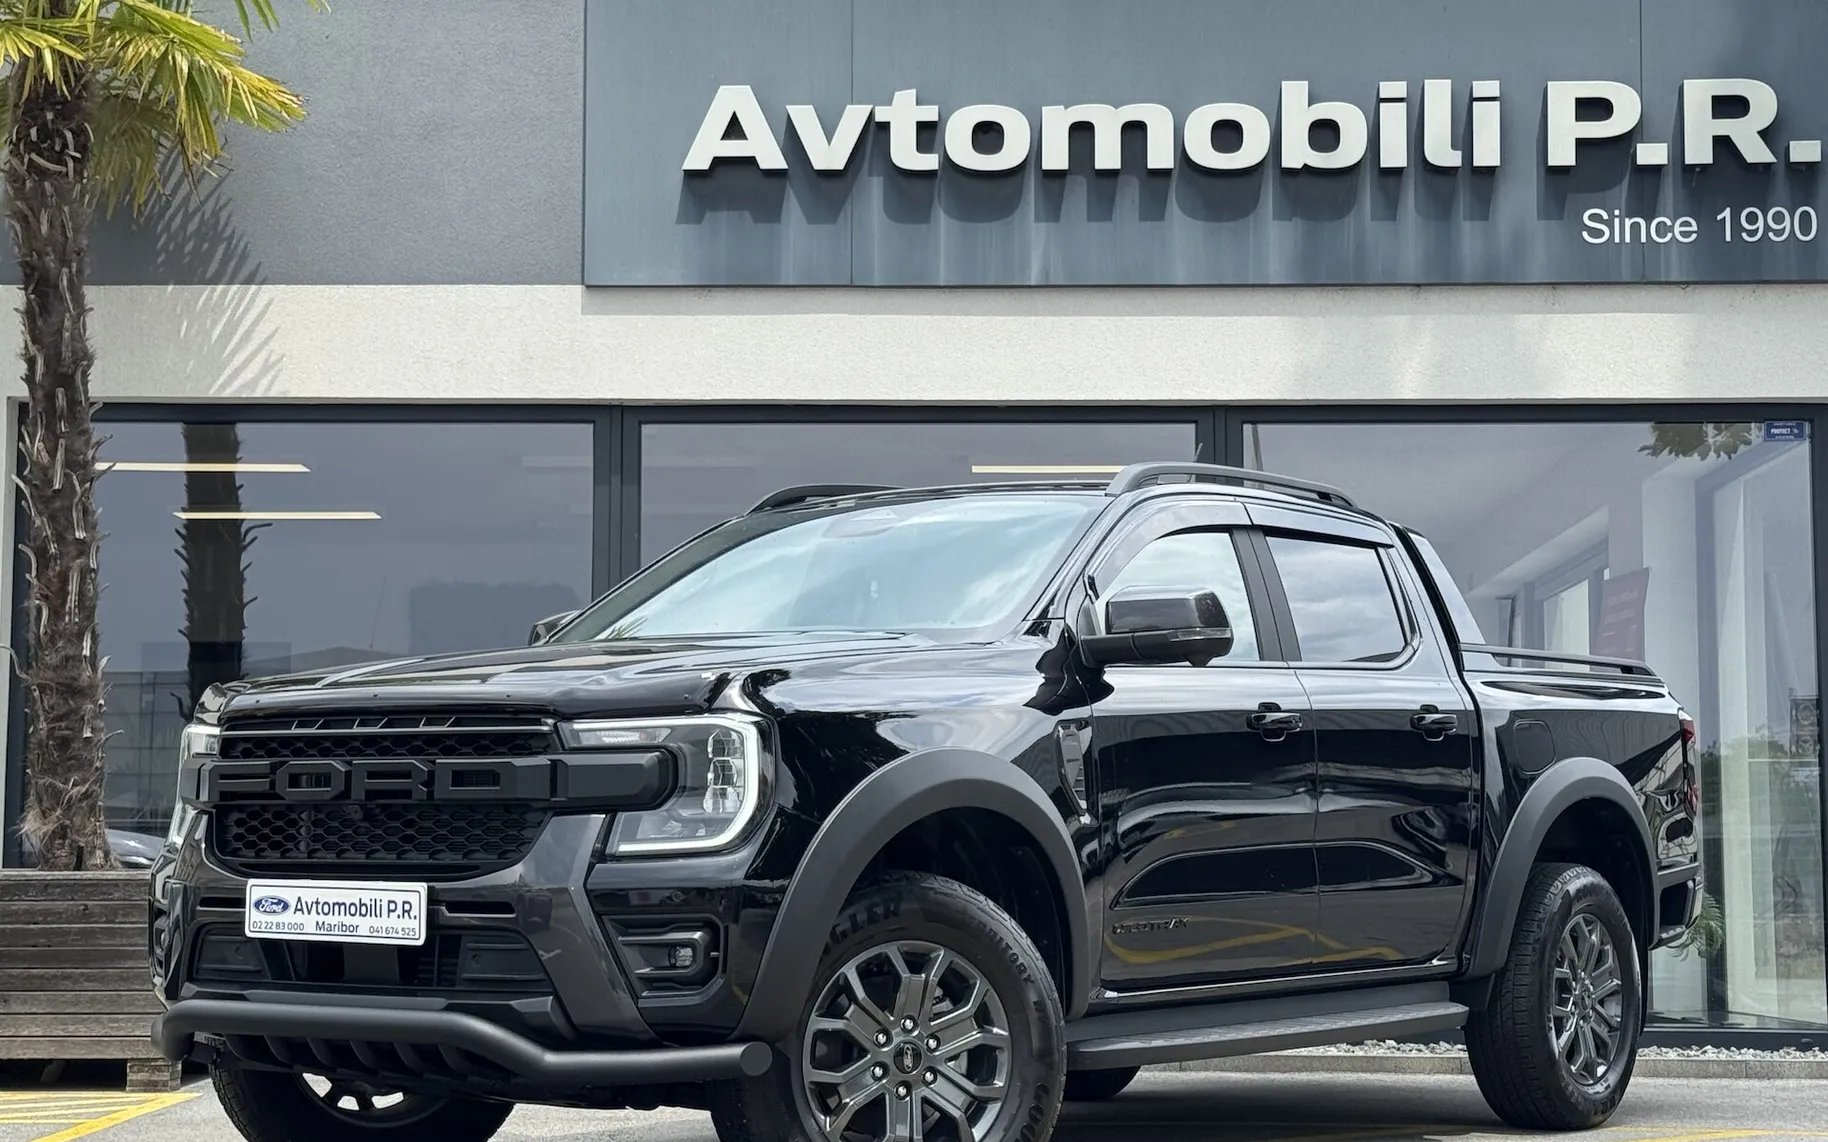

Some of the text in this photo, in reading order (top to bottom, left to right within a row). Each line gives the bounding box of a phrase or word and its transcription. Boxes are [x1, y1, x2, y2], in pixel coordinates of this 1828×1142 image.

[682, 78, 1821, 172] Avtomobili P.R.
[1581, 206, 1817, 243] Since 1990
[204, 758, 550, 802] FORD
[259, 898, 284, 912] Ford
[293, 896, 417, 920] Avtomobili P.R.
[287, 922, 304, 931] 000
[315, 920, 360, 933] Maribor
